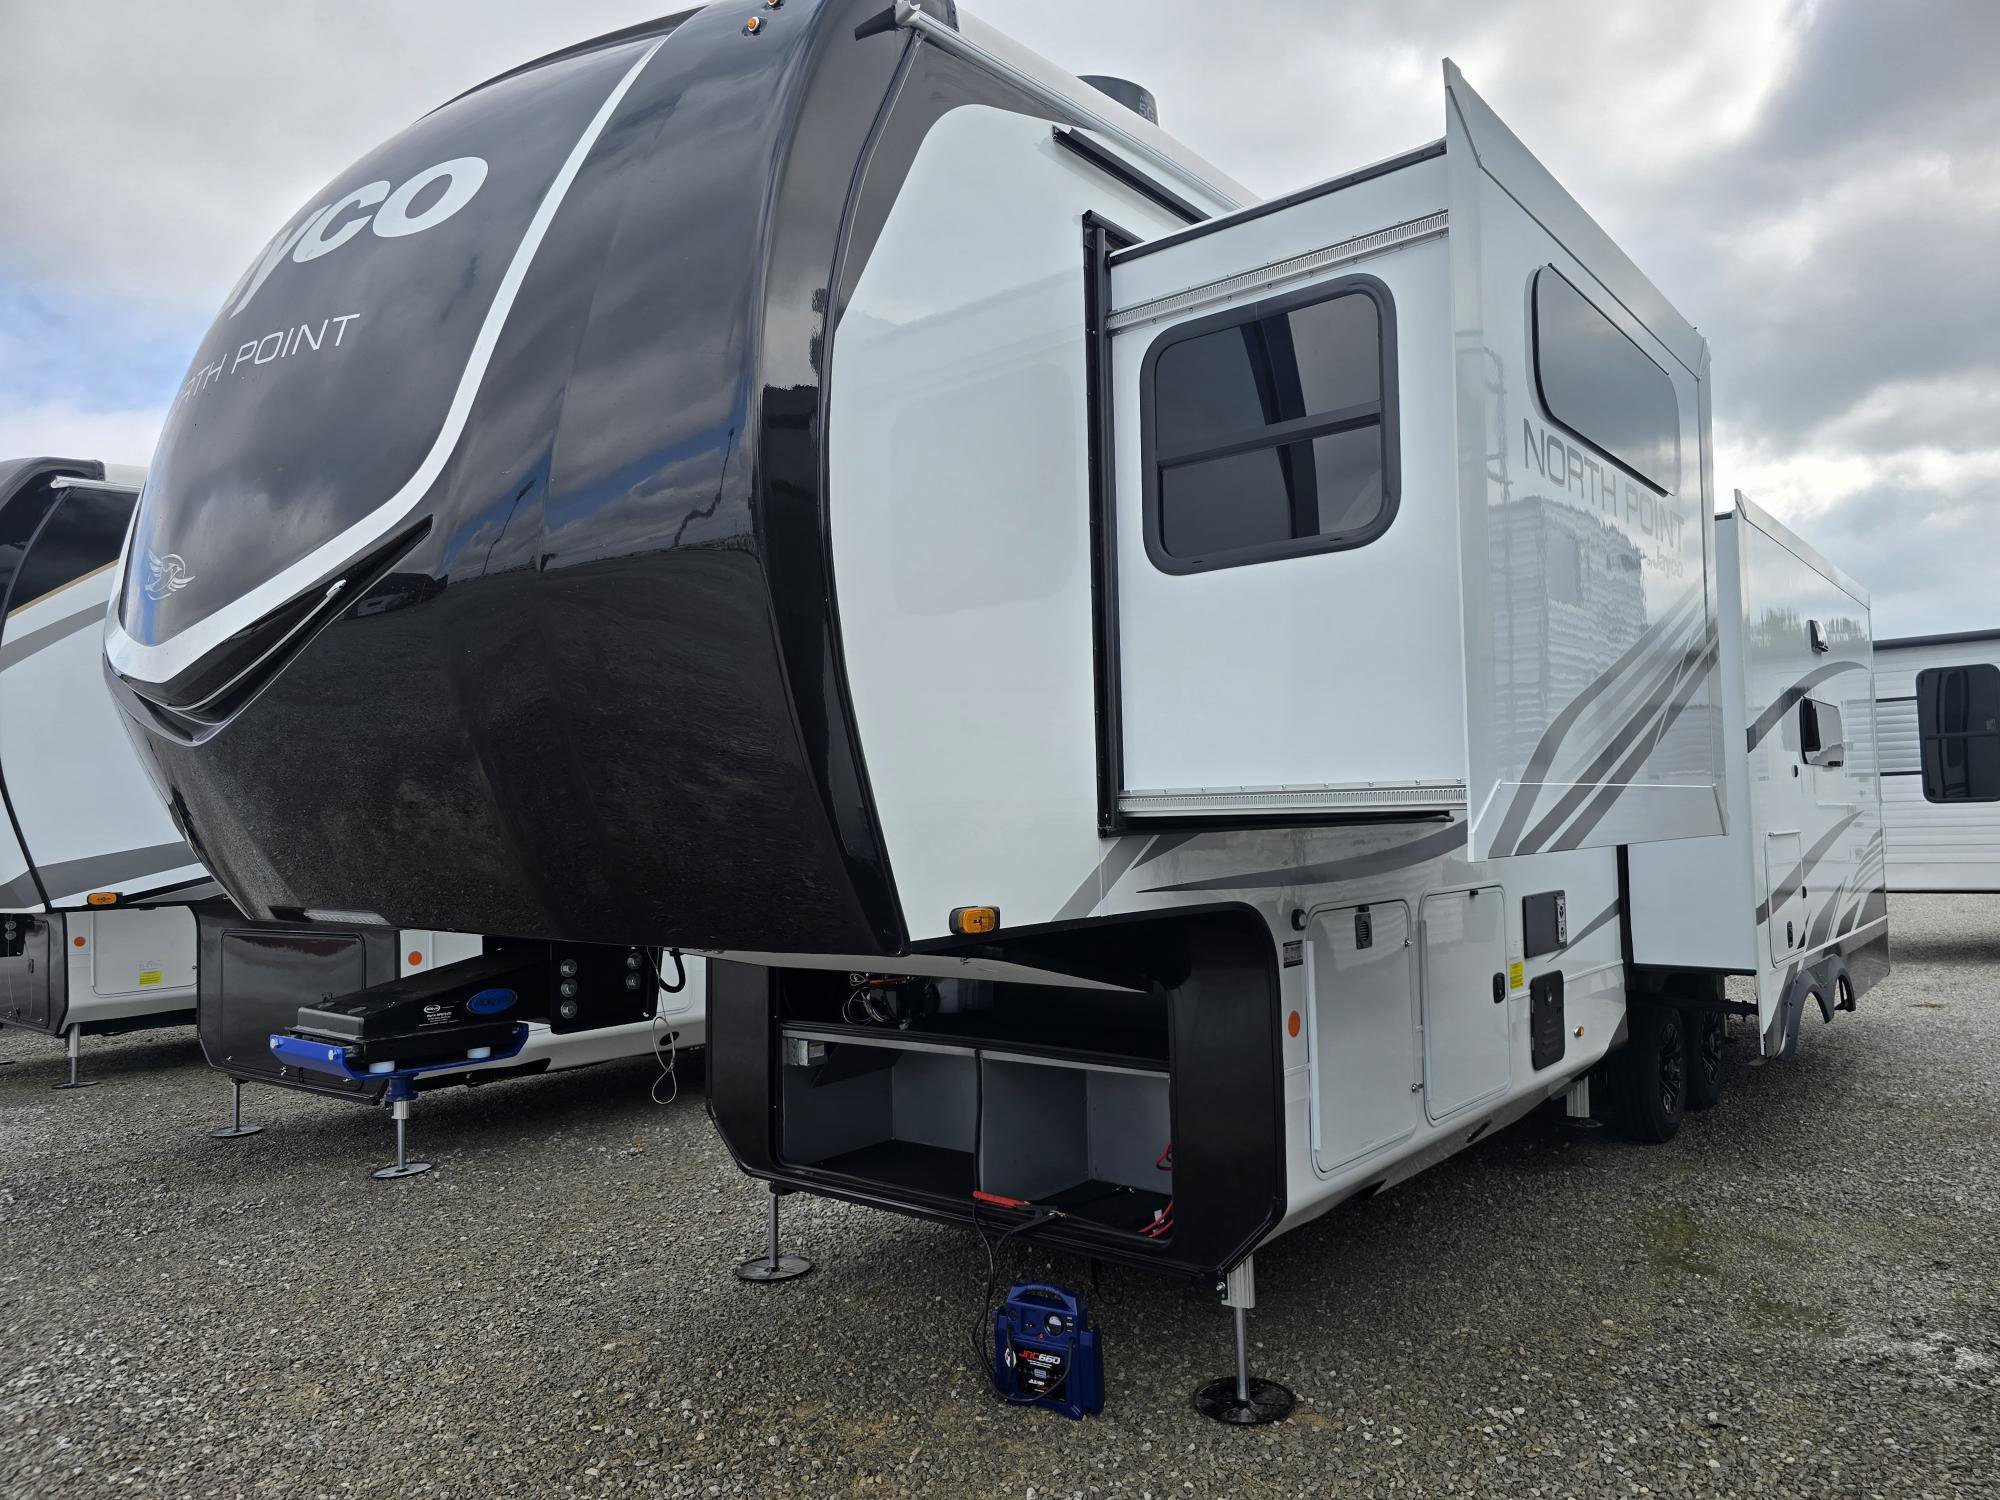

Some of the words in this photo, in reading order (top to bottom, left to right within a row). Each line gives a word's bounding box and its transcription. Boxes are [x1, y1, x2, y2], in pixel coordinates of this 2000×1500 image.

[231, 313, 361, 375] POINT
[1523, 418, 1617, 518] NORTH
[1625, 480, 1685, 553] POINT
[1653, 545, 1684, 579] Jayco
